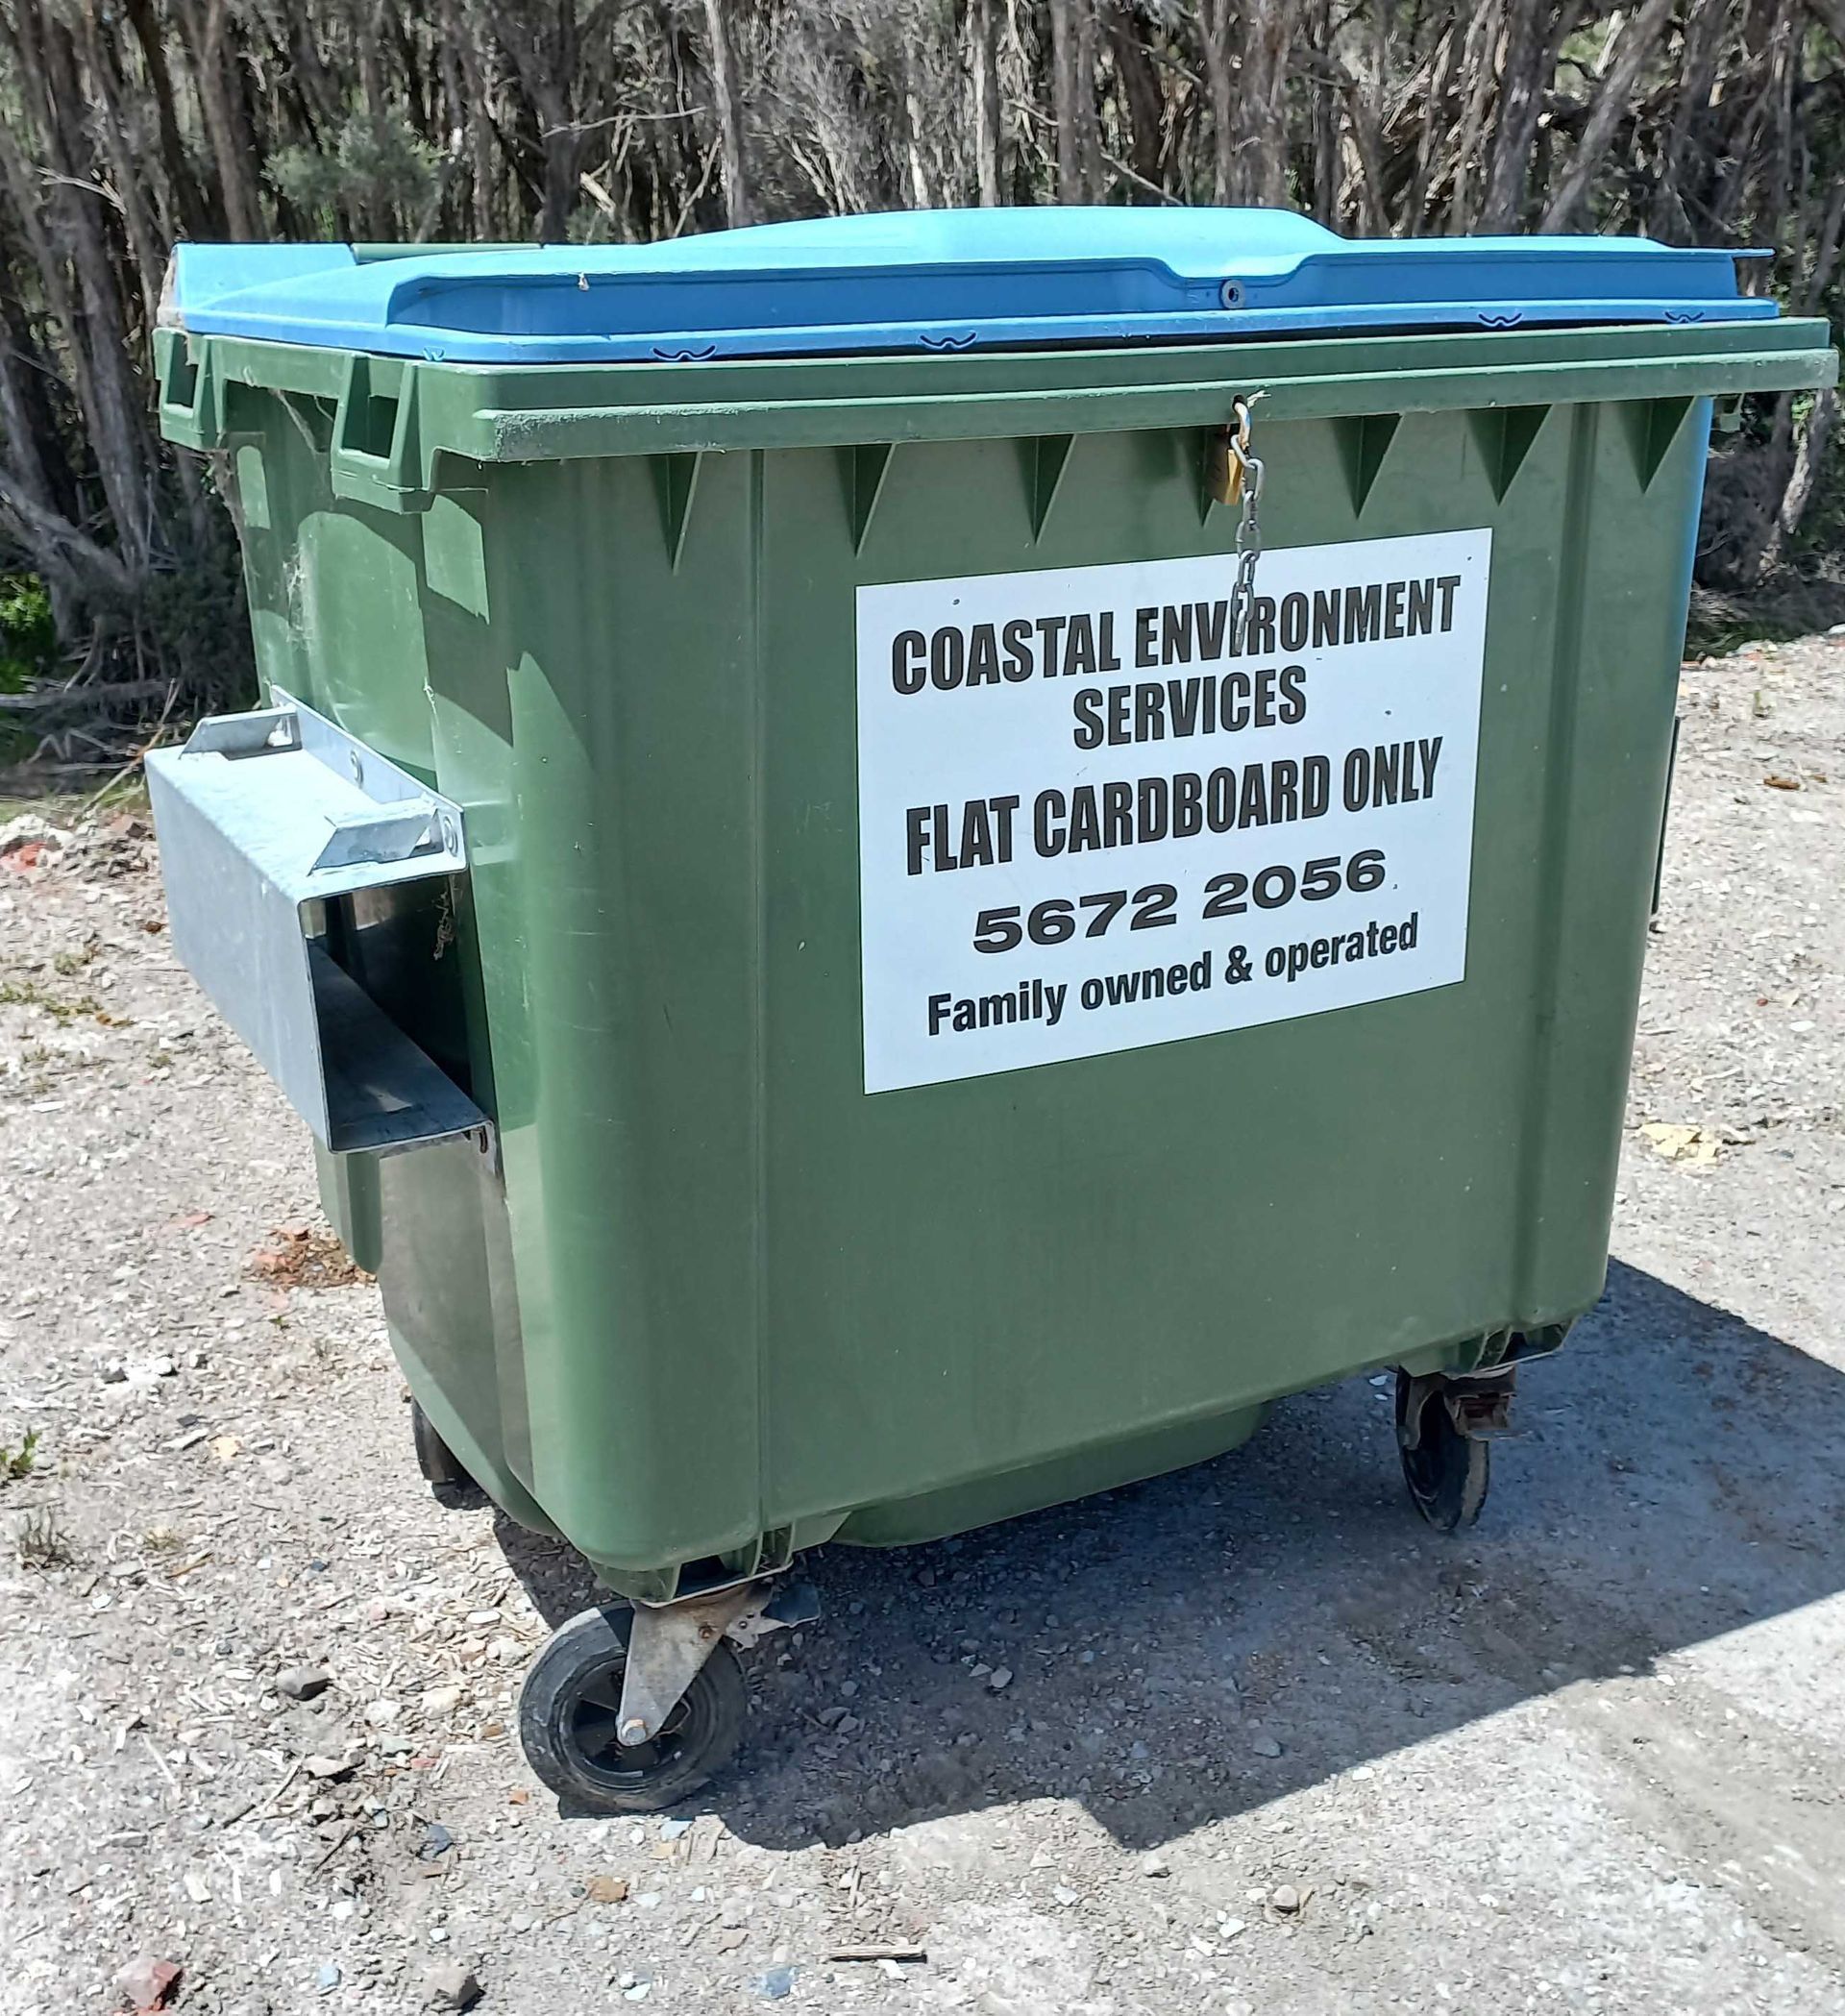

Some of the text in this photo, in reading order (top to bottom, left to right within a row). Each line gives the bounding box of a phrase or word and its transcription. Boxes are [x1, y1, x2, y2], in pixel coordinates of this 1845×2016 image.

[892, 611, 1121, 695] COASTAL
[1073, 665, 1307, 750] SERVICES
[906, 736, 1443, 876] FLAT CARDBOARD ONLY
[972, 848, 1386, 954] 5672 2056
[928, 911, 1418, 1037] Family owned & operated
